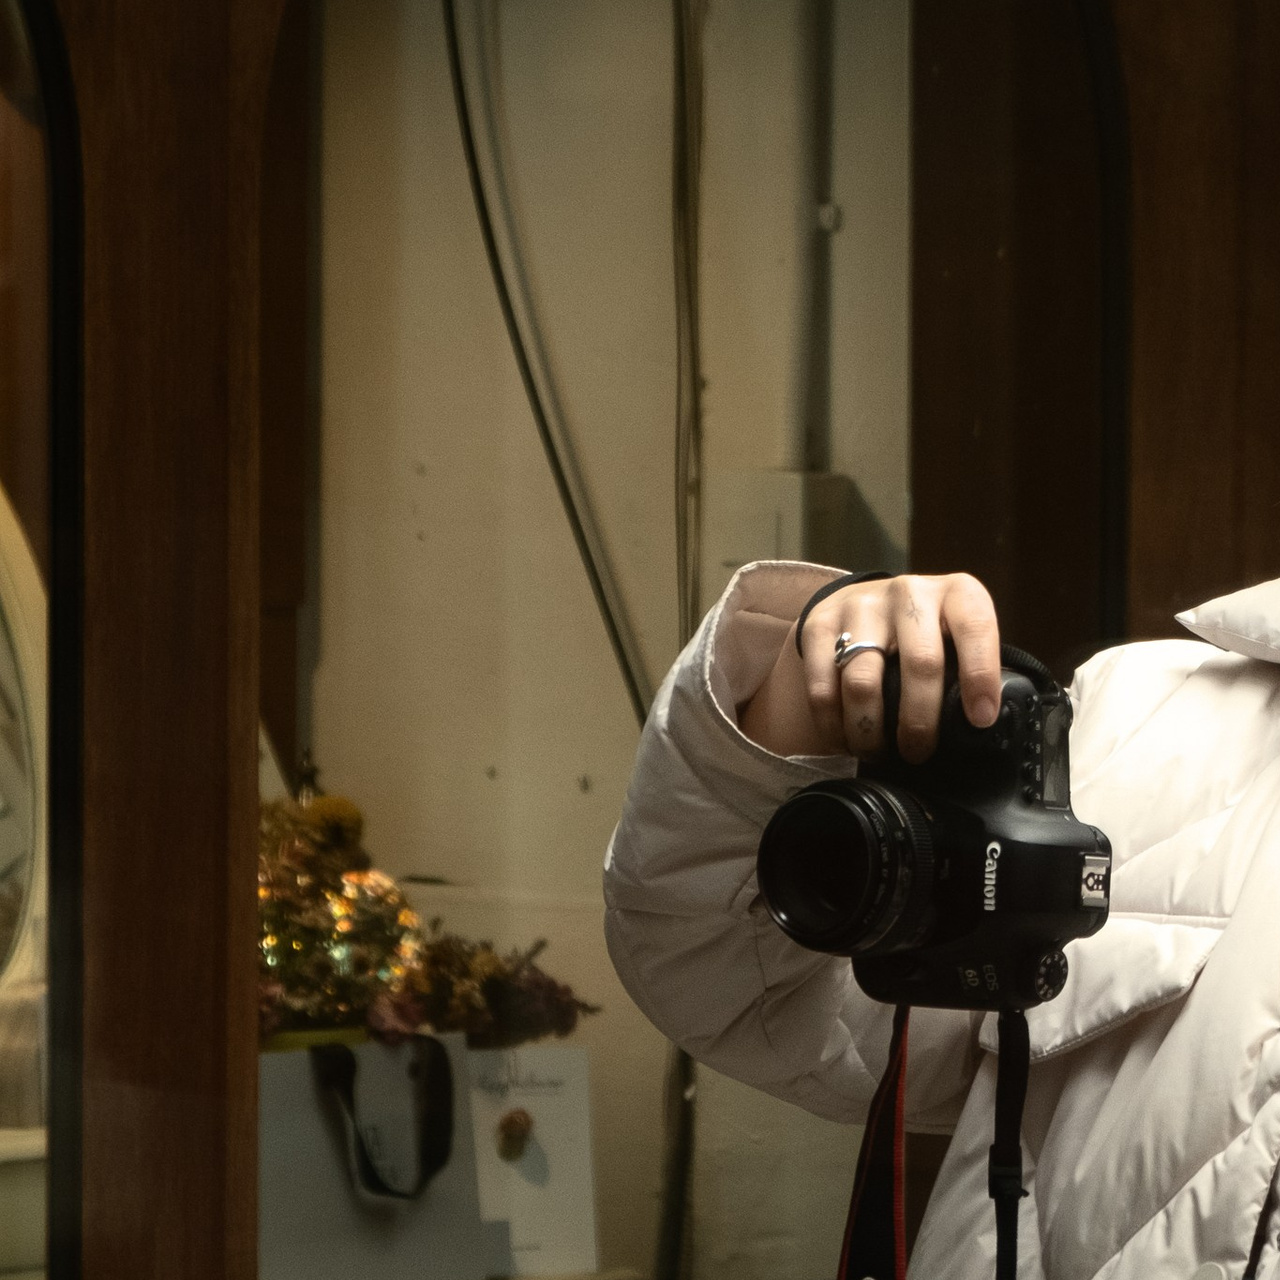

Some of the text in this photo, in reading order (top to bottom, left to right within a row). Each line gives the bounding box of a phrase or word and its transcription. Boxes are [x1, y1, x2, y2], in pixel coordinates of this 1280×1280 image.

[984, 841, 1001, 911] Canon
[965, 969, 980, 987] 6D
[982, 964, 999, 991] EOS
